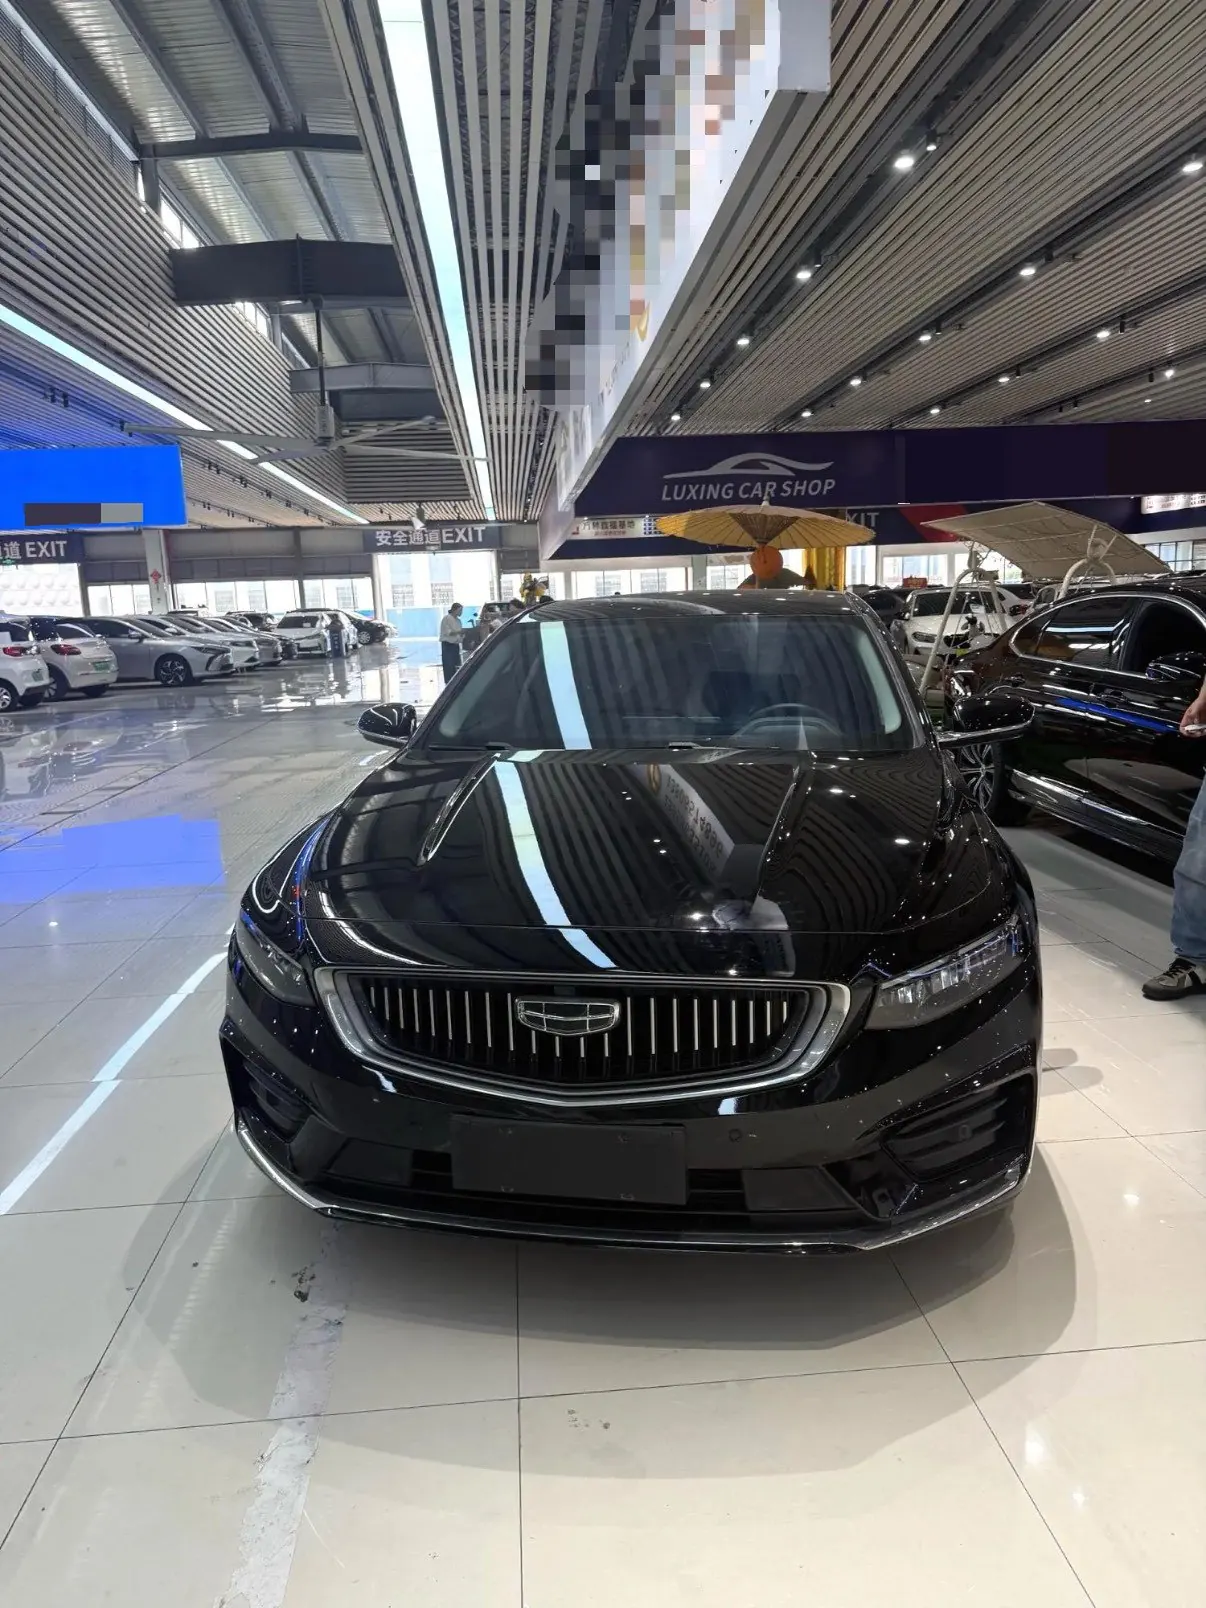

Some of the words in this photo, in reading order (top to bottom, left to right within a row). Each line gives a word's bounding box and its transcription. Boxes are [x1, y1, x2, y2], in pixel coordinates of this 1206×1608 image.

[662, 483, 735, 501] LUXING
[738, 481, 777, 499] CAR
[780, 479, 836, 497] SHOP
[846, 512, 880, 527] XIT
[375, 528, 441, 546] 安全通道
[442, 526, 486, 544] EXIT
[0, 541, 22, 559] 道
[25, 541, 67, 558] EXIT
